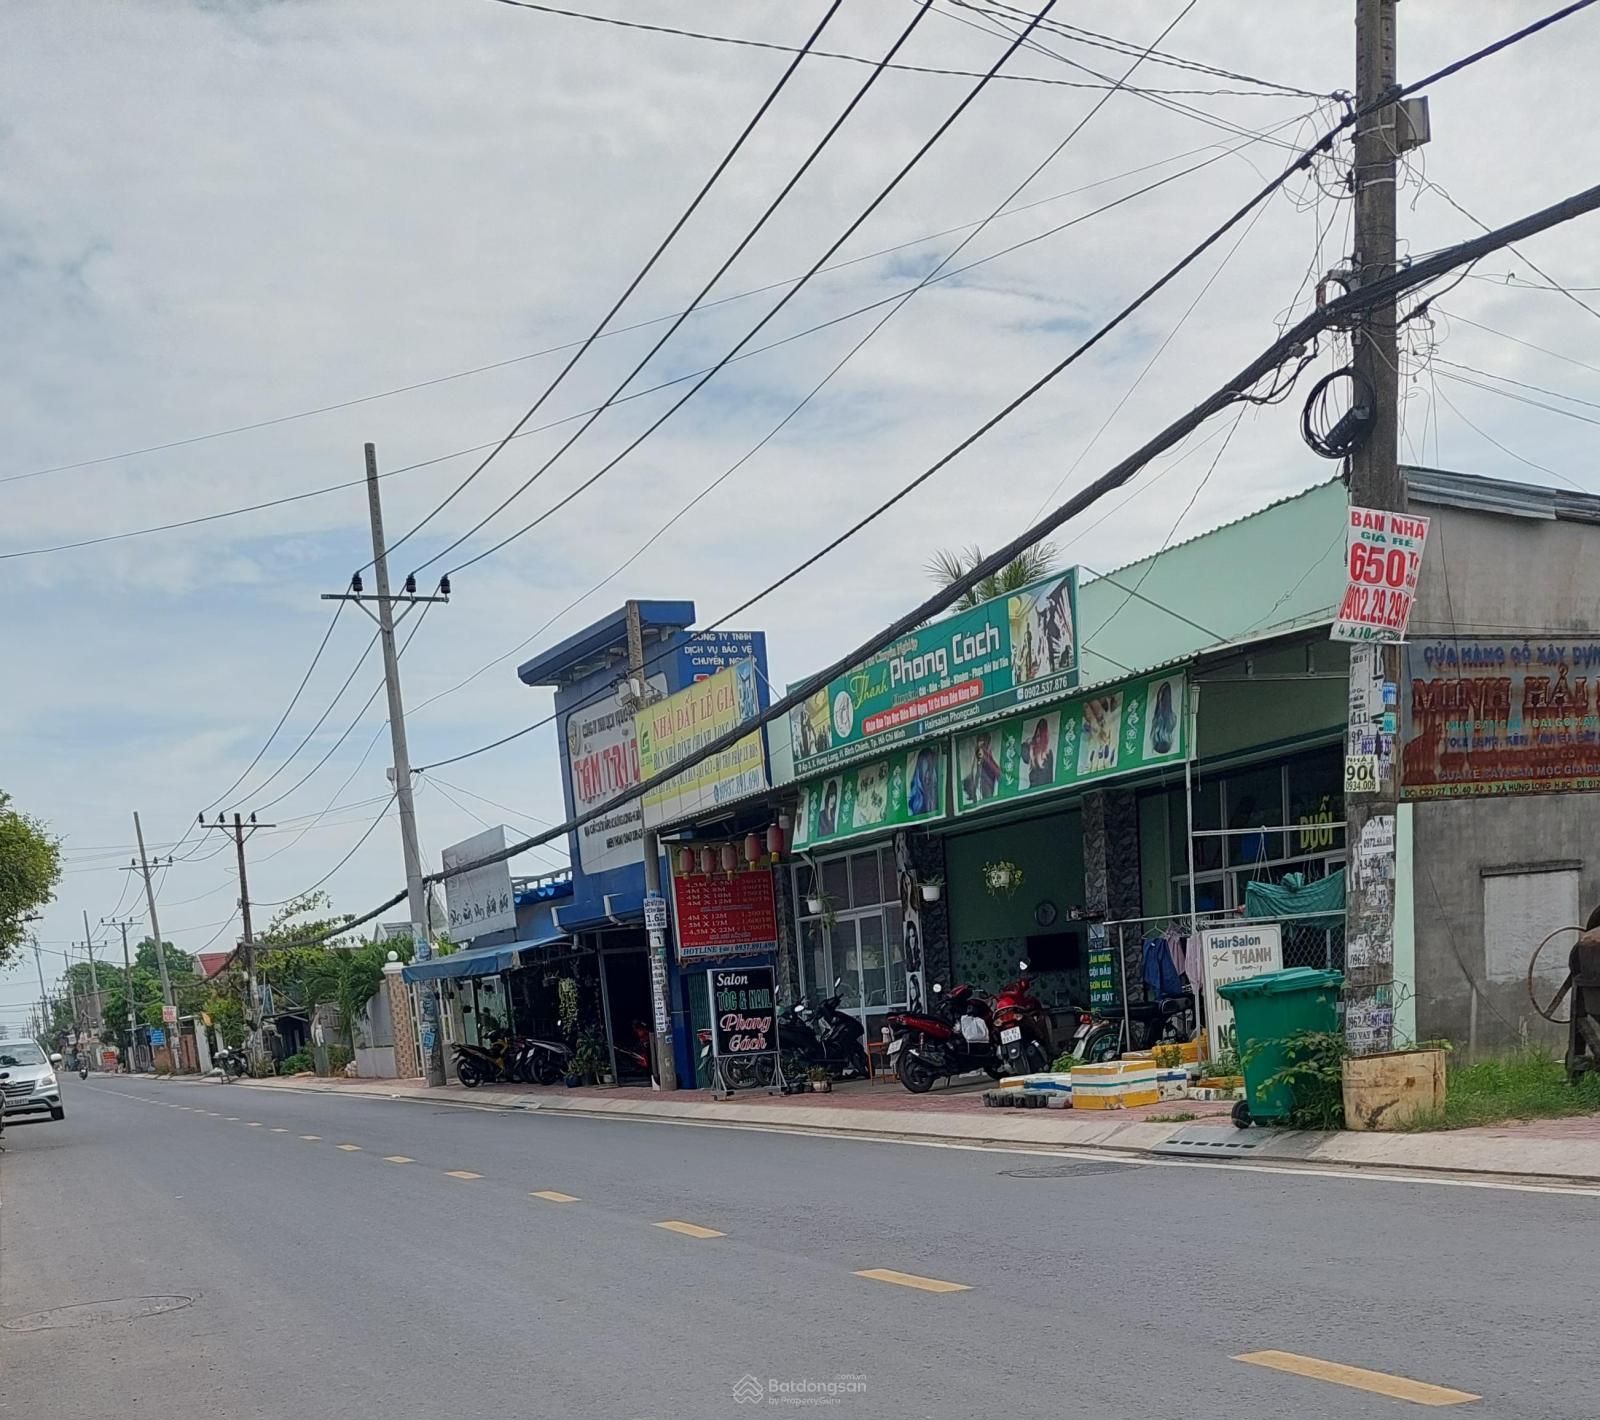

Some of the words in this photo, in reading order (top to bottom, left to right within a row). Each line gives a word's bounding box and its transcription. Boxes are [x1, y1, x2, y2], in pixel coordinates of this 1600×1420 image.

[1351, 510, 1385, 531] BÁN
[1391, 517, 1425, 540] NHÀ
[1361, 531, 1386, 543] GIÁ
[1350, 542, 1406, 588] 650
[719, 633, 728, 641] TY
[732, 633, 752, 641] TNHH
[684, 646, 703, 656] DỊCH
[692, 655, 724, 665] CHUYÊN
[1461, 643, 1505, 665] HÀNG
[1537, 643, 1565, 665] XÂY
[850, 667, 889, 709] Thanh
[889, 647, 948, 688] Phong
[952, 622, 999, 665] Cách
[1024, 676, 1068, 699] 0902.537.876
[653, 707, 673, 740] NHÀ
[677, 693, 697, 731] ĐẤT
[700, 687, 714, 720] LÊ
[717, 685, 736, 712] GIA
[949, 705, 980, 723] Phongcach
[683, 945, 717, 956] HOTLINE
[1210, 934, 1261, 950] HairSalon
[1232, 946, 1272, 965] THANH
[716, 973, 749, 987] Salon
[716, 987, 737, 1012] TÓC
[739, 990, 748, 1010] &
[748, 988, 772, 1010] NAIL
[720, 1013, 772, 1033] Phong
[728, 1032, 767, 1052] Cách
